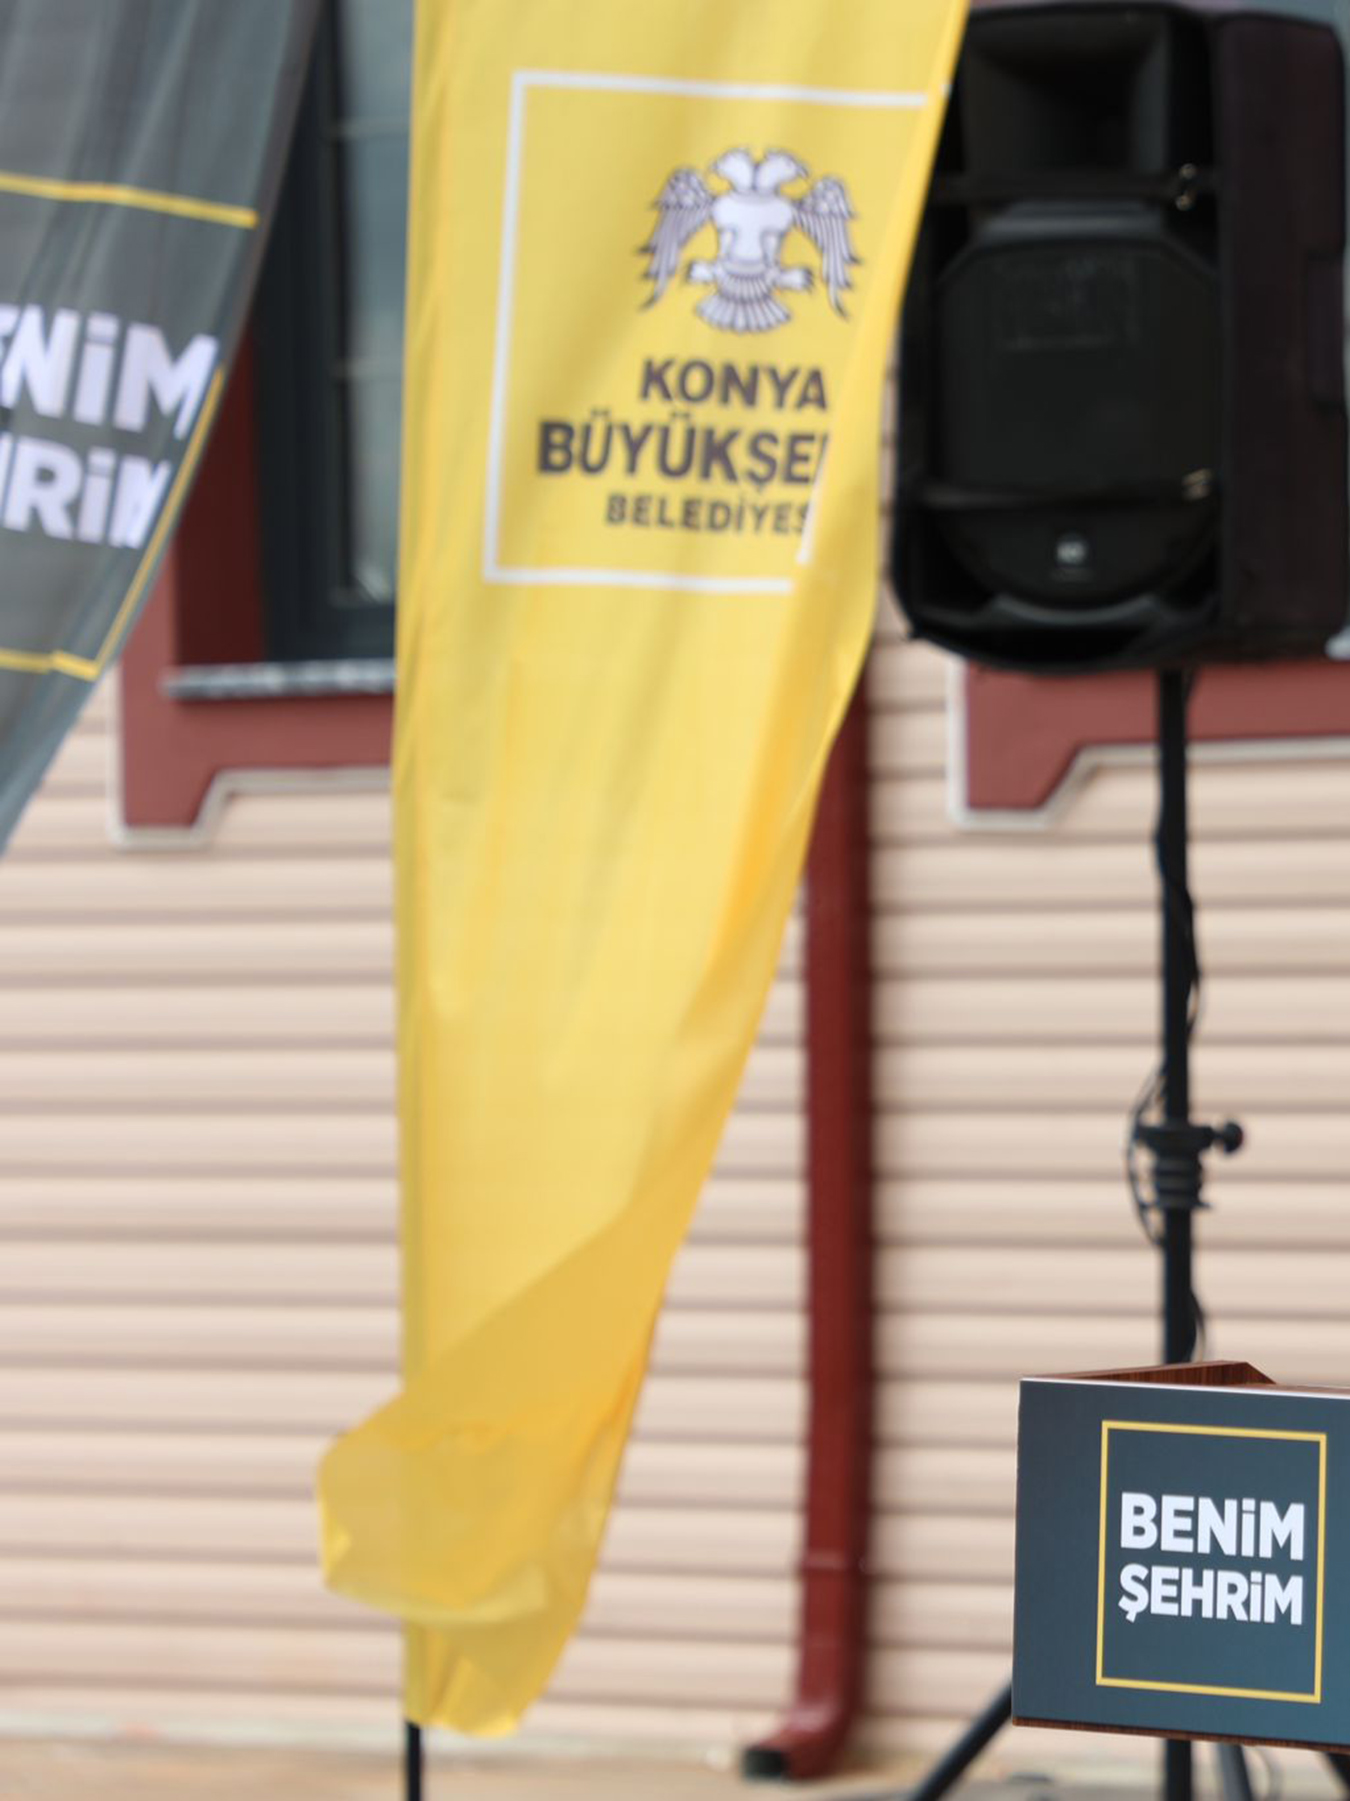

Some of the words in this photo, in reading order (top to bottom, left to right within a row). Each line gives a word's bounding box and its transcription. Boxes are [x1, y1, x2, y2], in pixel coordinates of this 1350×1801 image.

[639, 357, 830, 413] KONYA
[537, 407, 830, 496] BÜYÜKŞE
[1120, 1491, 1305, 1561] BENİM
[1117, 1562, 1304, 1626] ŞEHRİM
